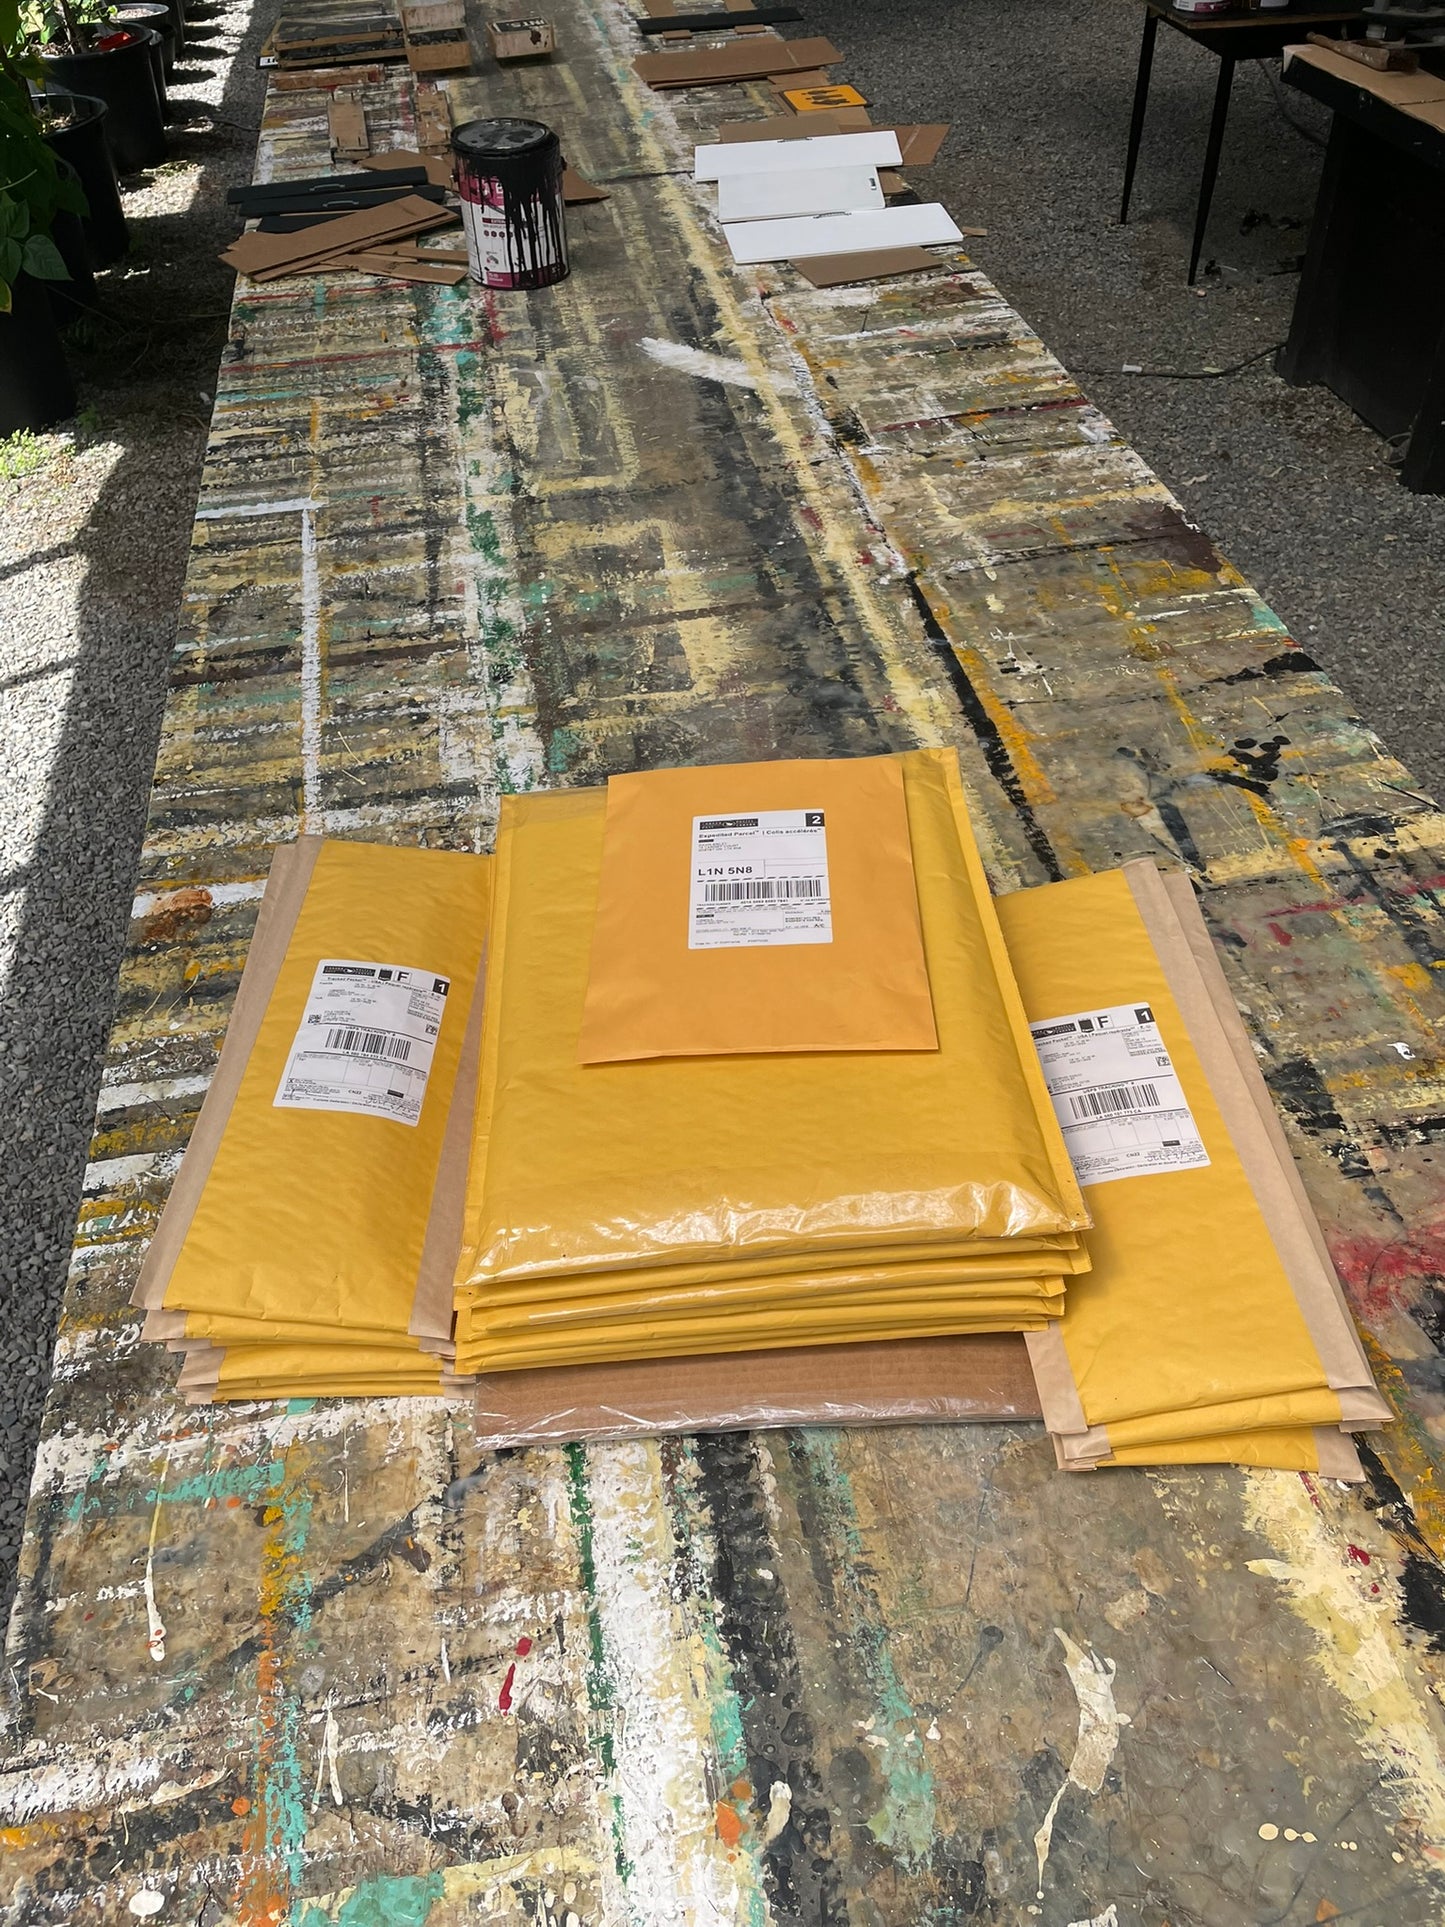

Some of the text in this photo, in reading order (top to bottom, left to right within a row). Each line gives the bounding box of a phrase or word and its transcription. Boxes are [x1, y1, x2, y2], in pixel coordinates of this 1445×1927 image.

[812, 816, 821, 824] 2
[698, 866, 753, 876] L1N 5N8
[398, 972, 409, 981] F
[438, 984, 446, 993] 1
[1141, 1011, 1150, 1021] 1
[1097, 1016, 1108, 1028] F
